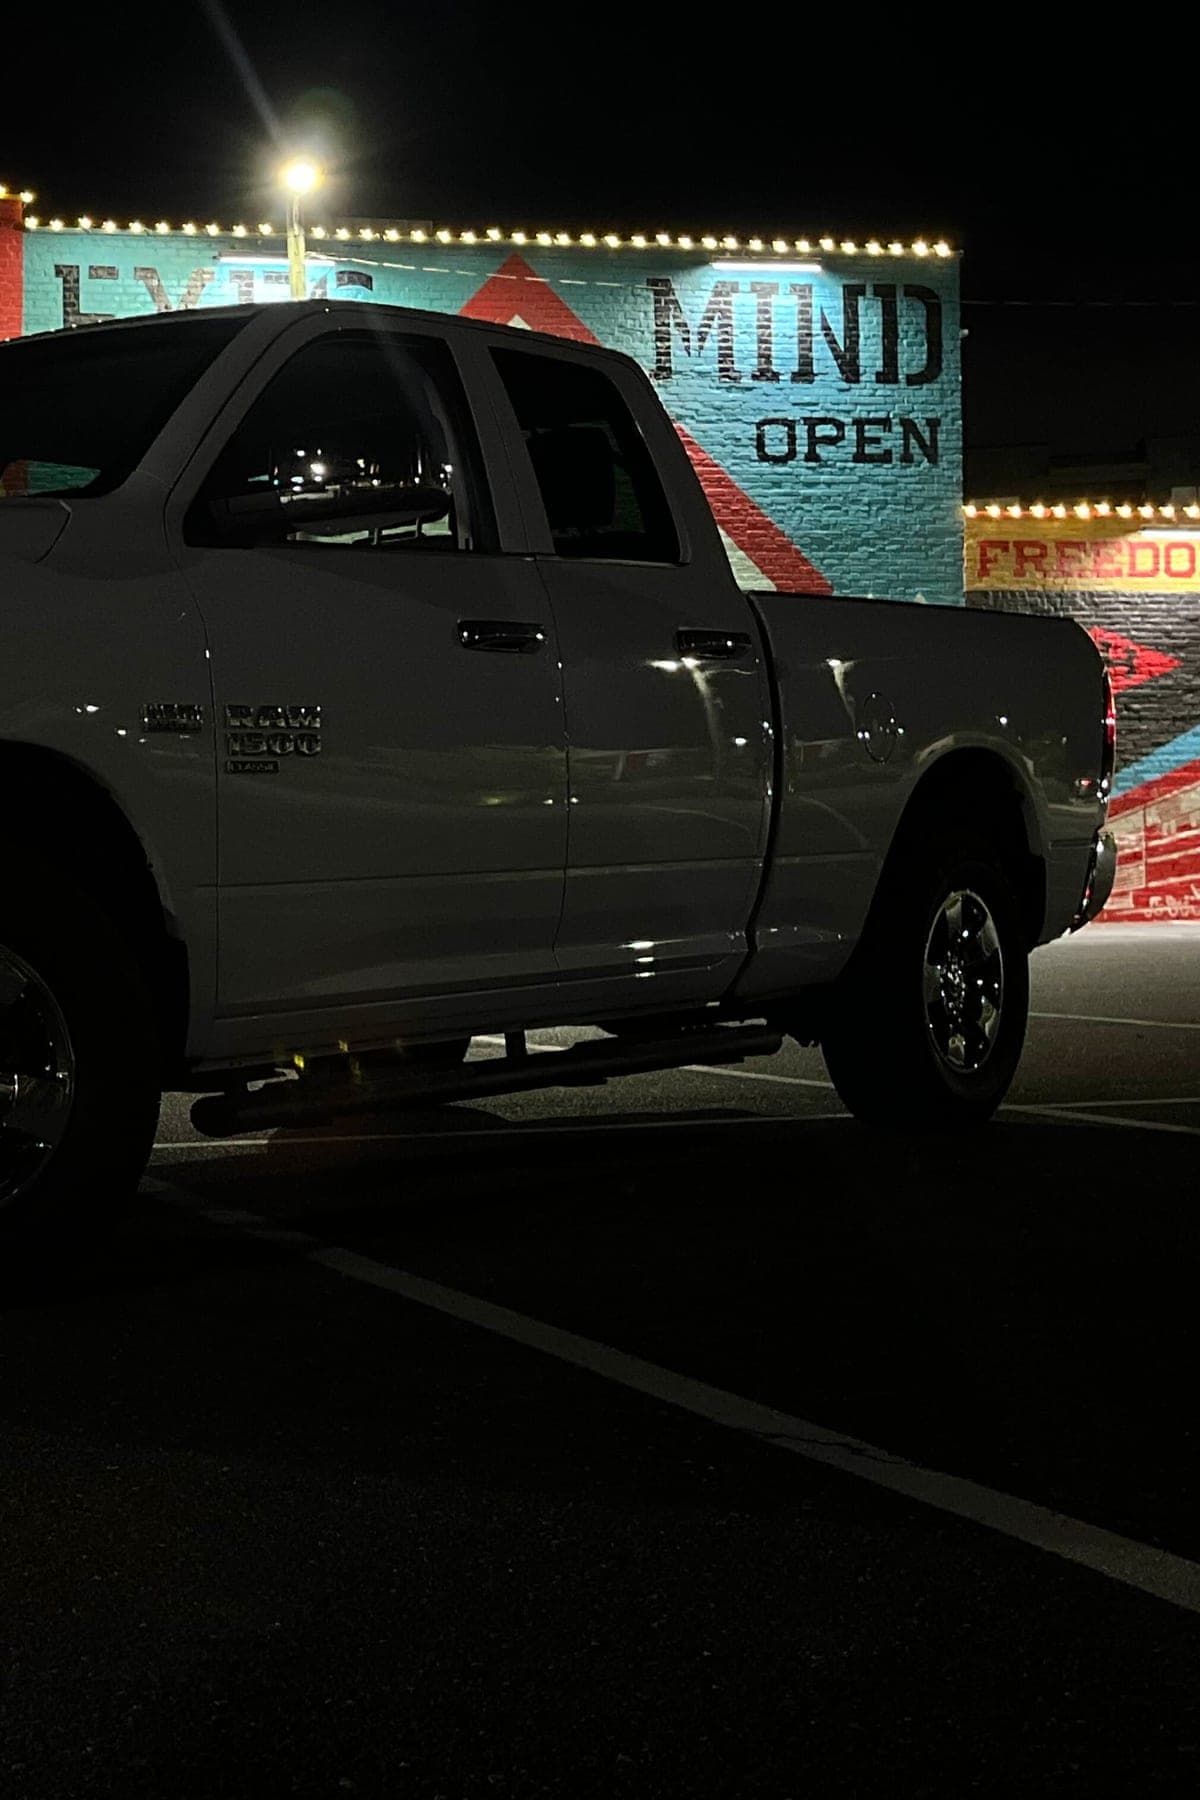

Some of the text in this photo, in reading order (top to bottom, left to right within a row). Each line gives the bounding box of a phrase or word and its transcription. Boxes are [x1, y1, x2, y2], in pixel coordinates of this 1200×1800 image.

[647, 278, 942, 385] MIND
[756, 417, 940, 464] OPEN
[977, 539, 1196, 578] FREEDO
[224, 704, 321, 729] RAM
[227, 733, 322, 757] 1500
